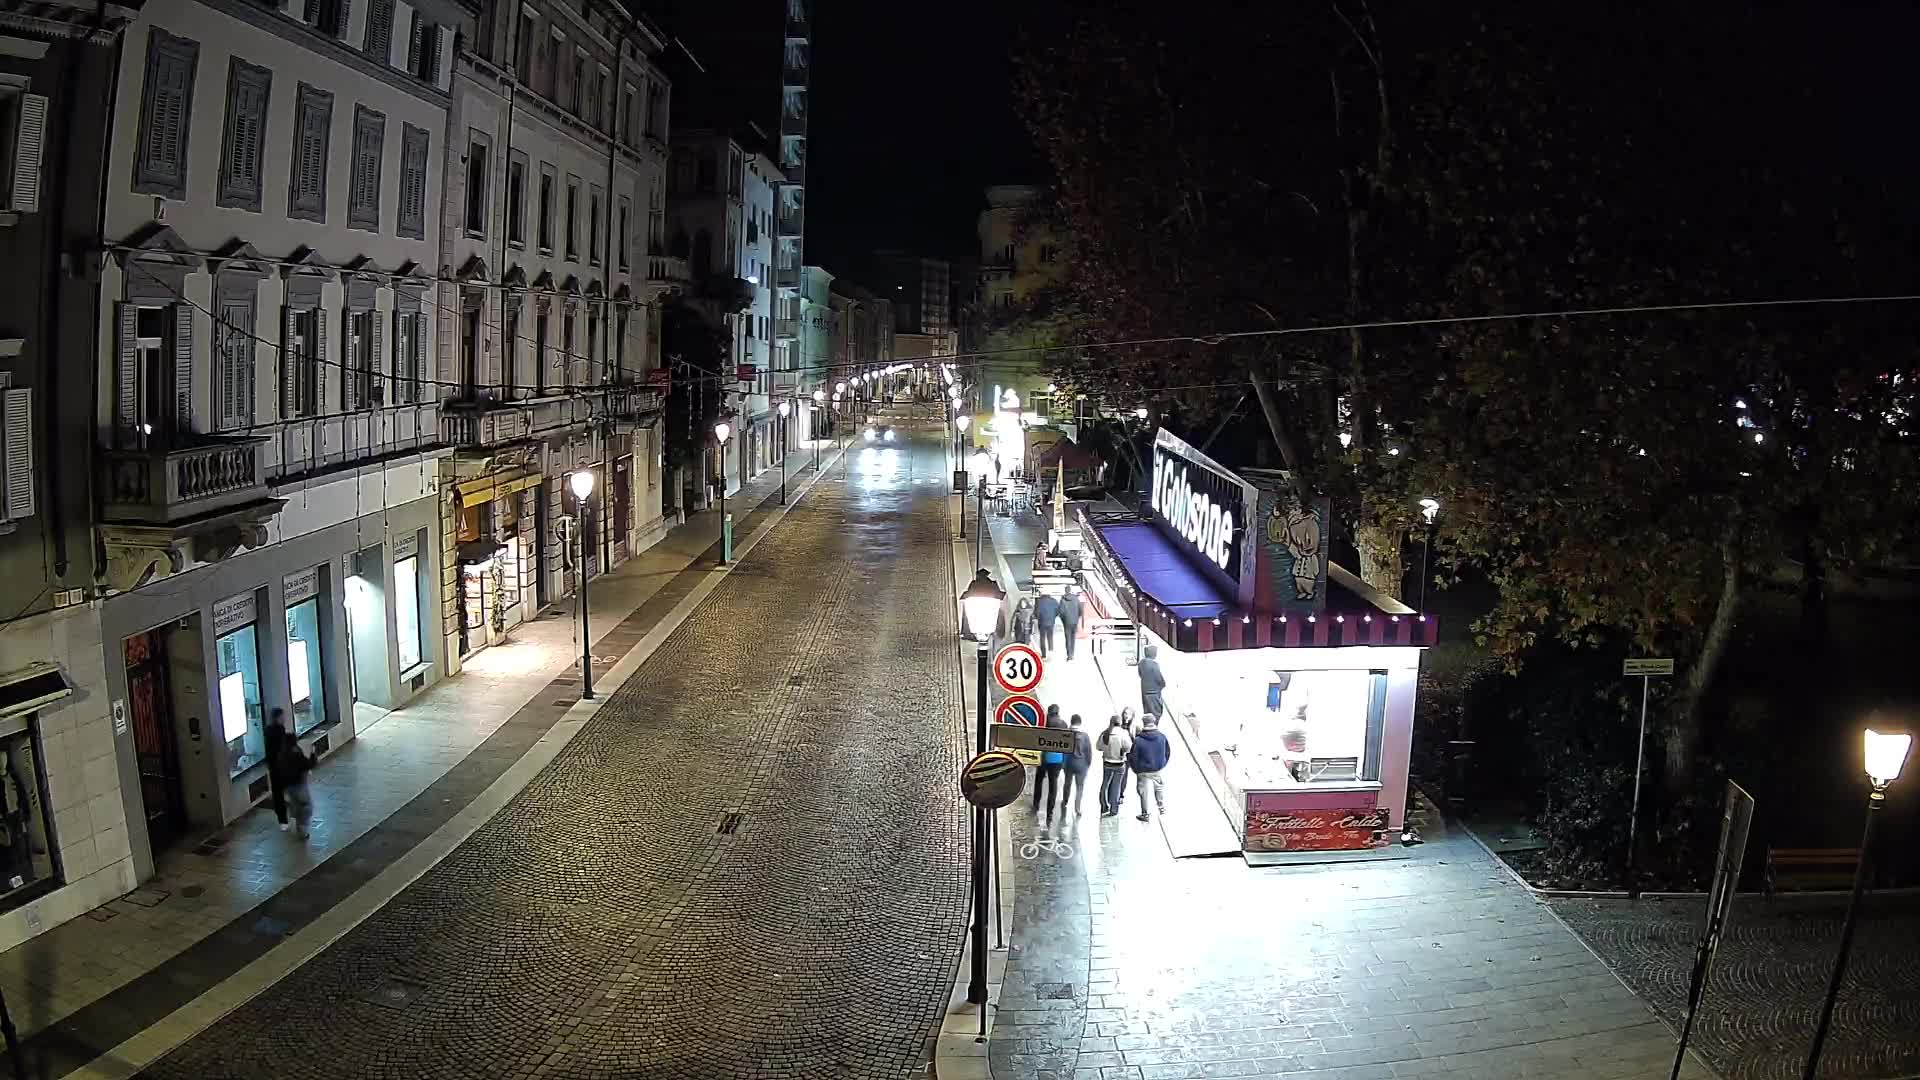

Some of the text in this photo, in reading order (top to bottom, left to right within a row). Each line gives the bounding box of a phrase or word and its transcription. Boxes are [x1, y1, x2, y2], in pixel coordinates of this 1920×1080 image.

[1161, 458, 1233, 570] Golosone
[1006, 657, 1033, 680] 30
[1038, 737, 1070, 750] Dante
